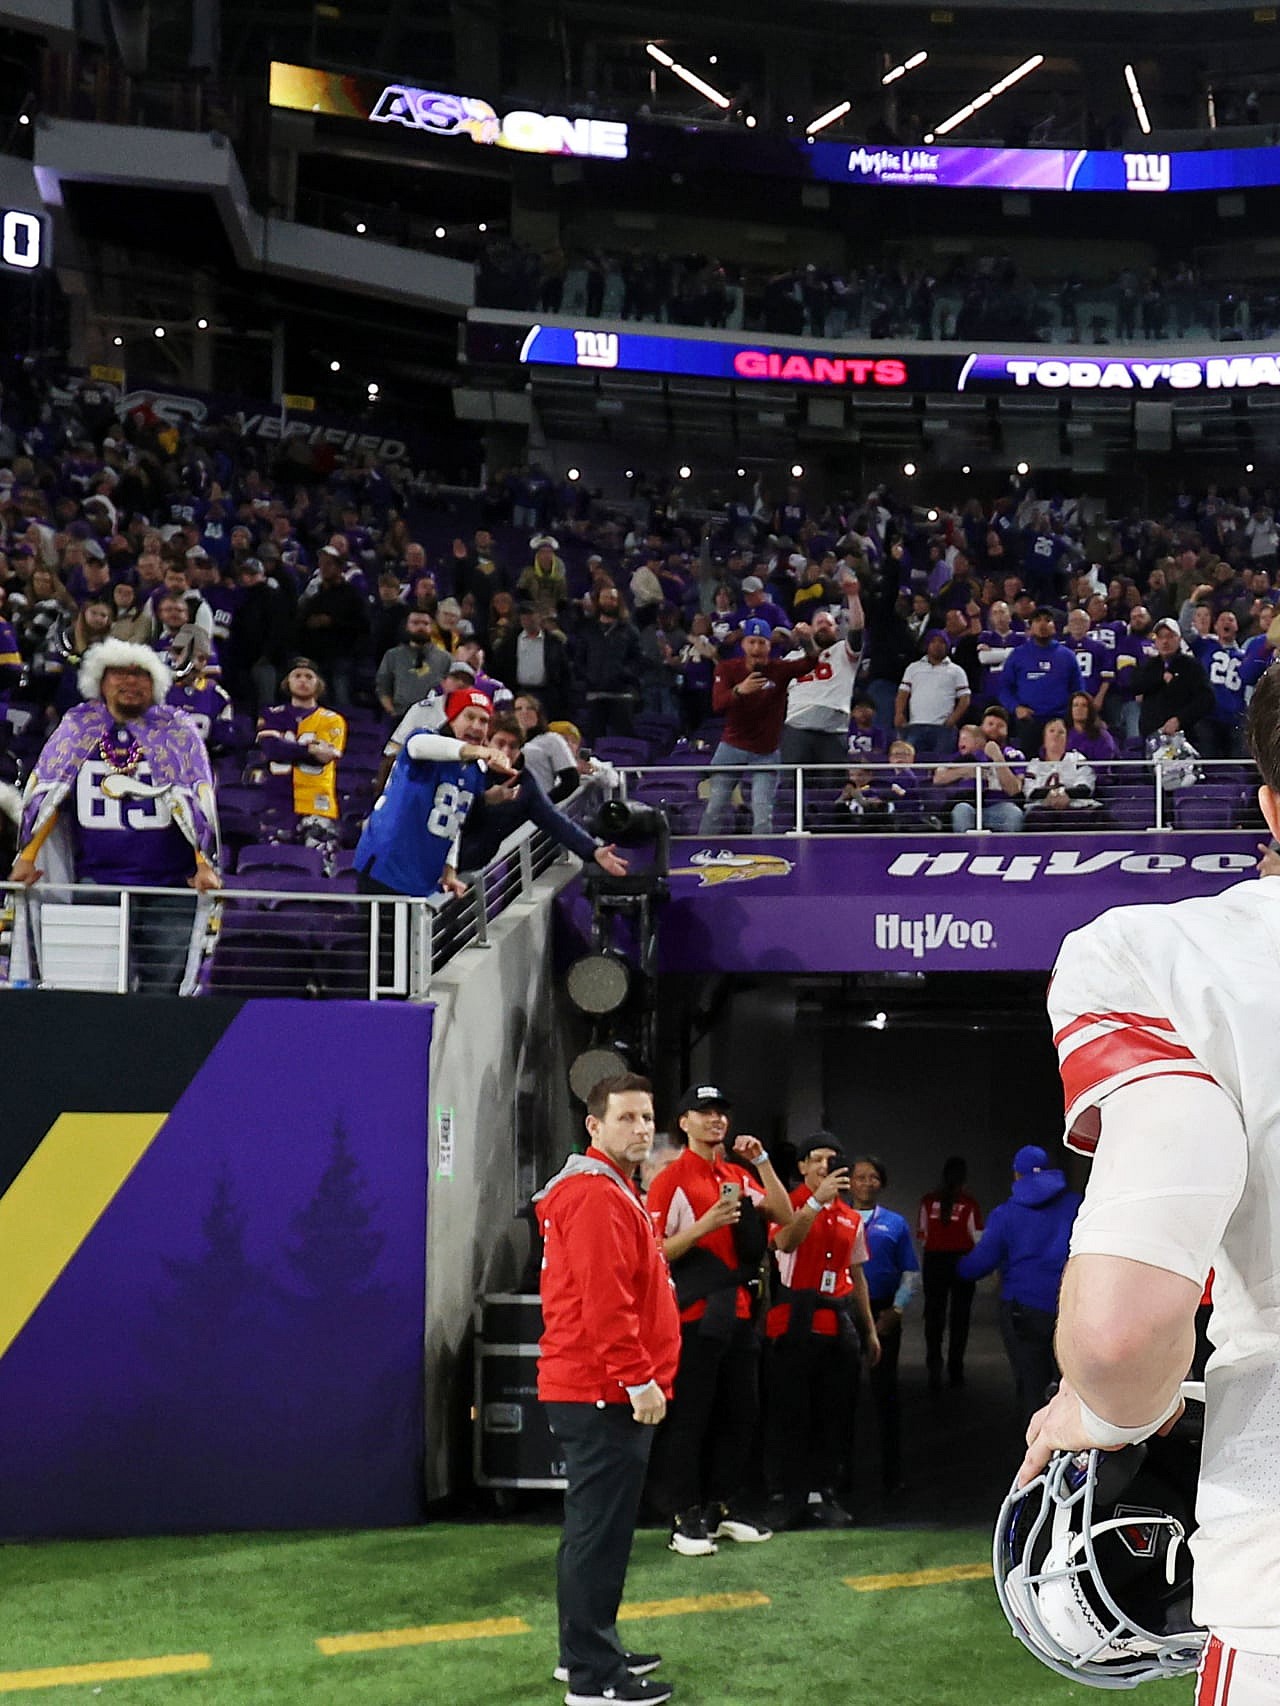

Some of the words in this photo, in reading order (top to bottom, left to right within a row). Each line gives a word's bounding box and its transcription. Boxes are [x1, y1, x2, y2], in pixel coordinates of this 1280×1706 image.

[501, 110, 629, 159] ONE
[733, 350, 908, 386] GIANTS
[1006, 361, 1202, 389] TODAY'S
[1210, 651, 1242, 691] 26
[886, 851, 1257, 882] HyVee
[874, 913, 994, 958] HyVee
